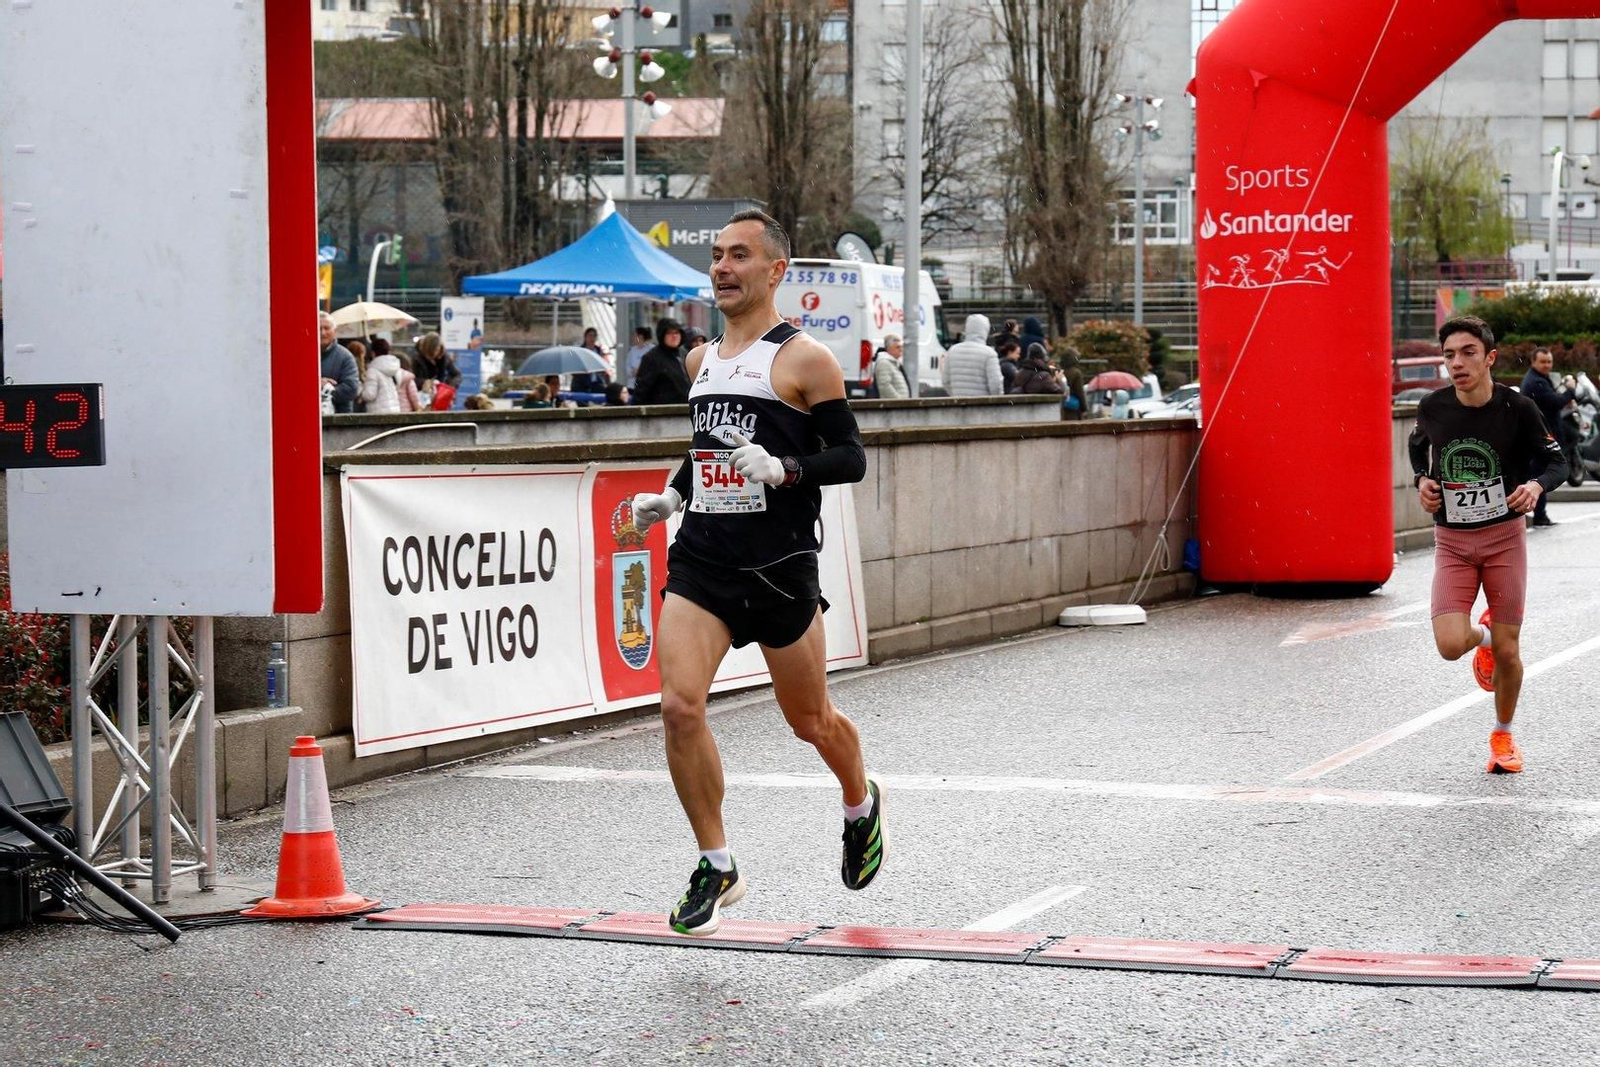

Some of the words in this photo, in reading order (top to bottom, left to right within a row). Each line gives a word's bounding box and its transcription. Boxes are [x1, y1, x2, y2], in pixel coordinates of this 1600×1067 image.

[1226, 164, 1309, 196] Sports
[1219, 208, 1353, 236] Santander
[797, 271, 814, 283] 55
[819, 271, 836, 284] 78
[841, 272, 858, 285] 98
[694, 401, 758, 433] delikia
[701, 464, 745, 488] 544
[1455, 489, 1491, 508] 271
[383, 527, 557, 596] CONCELLO
[408, 613, 453, 675] DE
[460, 603, 540, 665] VIGO
